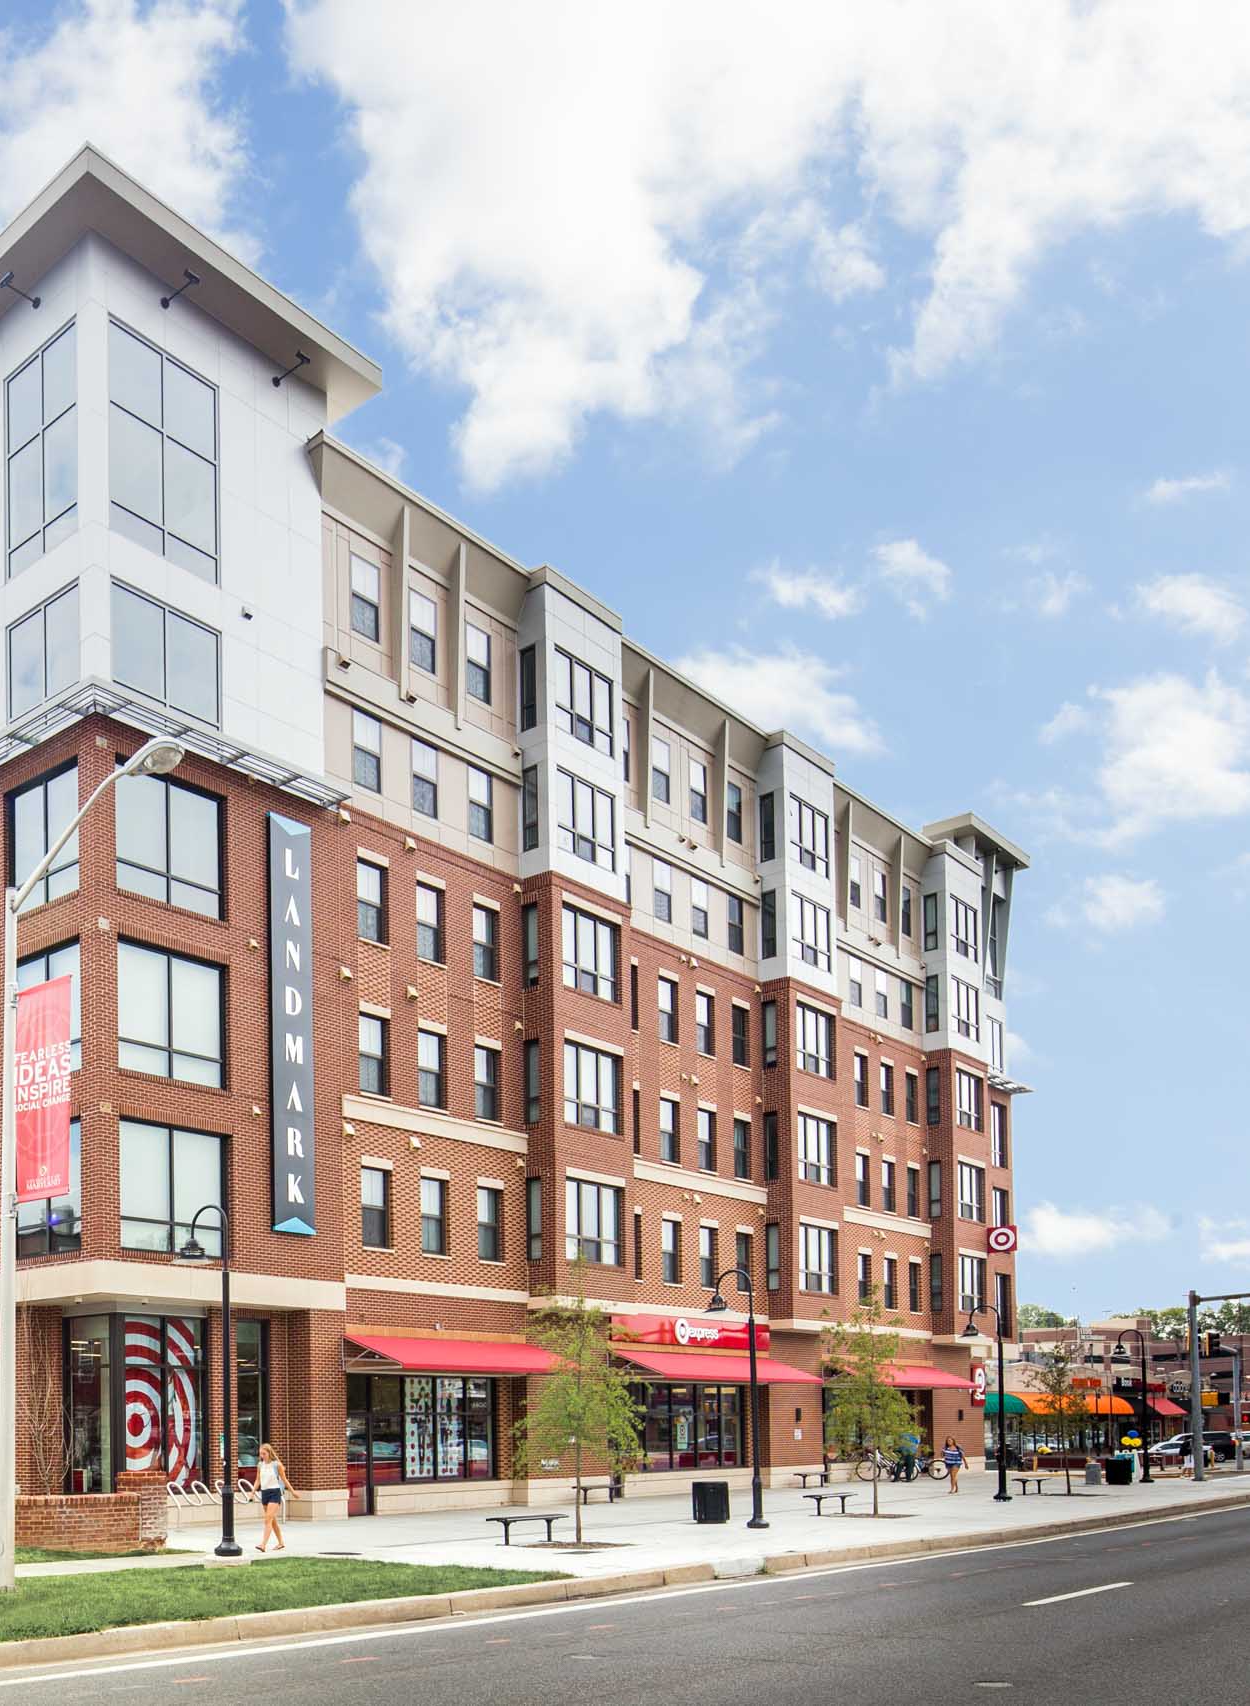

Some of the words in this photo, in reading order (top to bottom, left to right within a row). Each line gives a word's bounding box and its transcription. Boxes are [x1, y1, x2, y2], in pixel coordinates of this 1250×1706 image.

[284, 847, 306, 1204] LANDMARK
[14, 1040, 70, 1064] FEARLESS
[14, 1053, 70, 1087] IDEAS
[14, 1076, 70, 1104] INSPIRE
[689, 1327, 719, 1341] express
